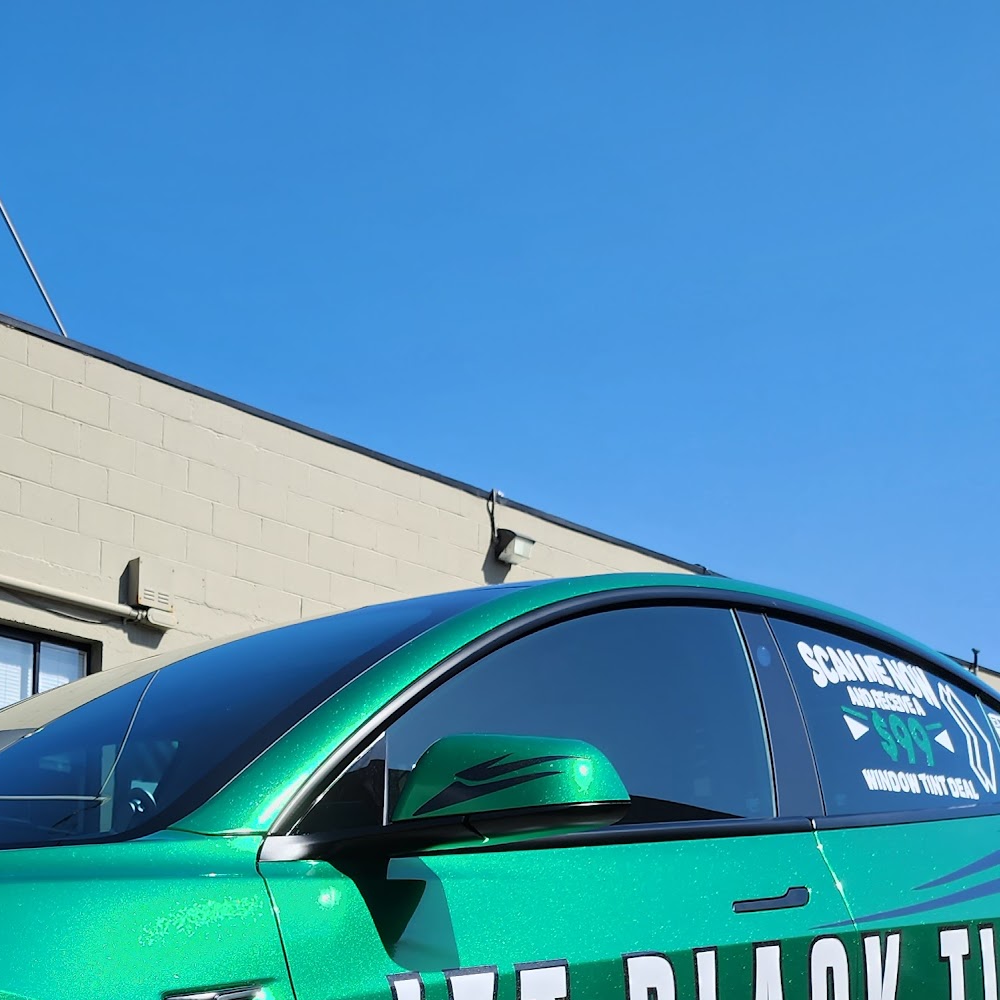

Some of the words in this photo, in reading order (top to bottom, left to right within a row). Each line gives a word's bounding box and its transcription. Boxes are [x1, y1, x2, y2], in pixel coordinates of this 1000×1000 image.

[797, 641, 859, 688] SCAN
[854, 653, 895, 688] ME
[883, 658, 941, 710] NOW
[846, 685, 876, 709] AND
[861, 768, 921, 794] WINDOW
[918, 773, 949, 796] TINT
[946, 777, 979, 800] DEAL
